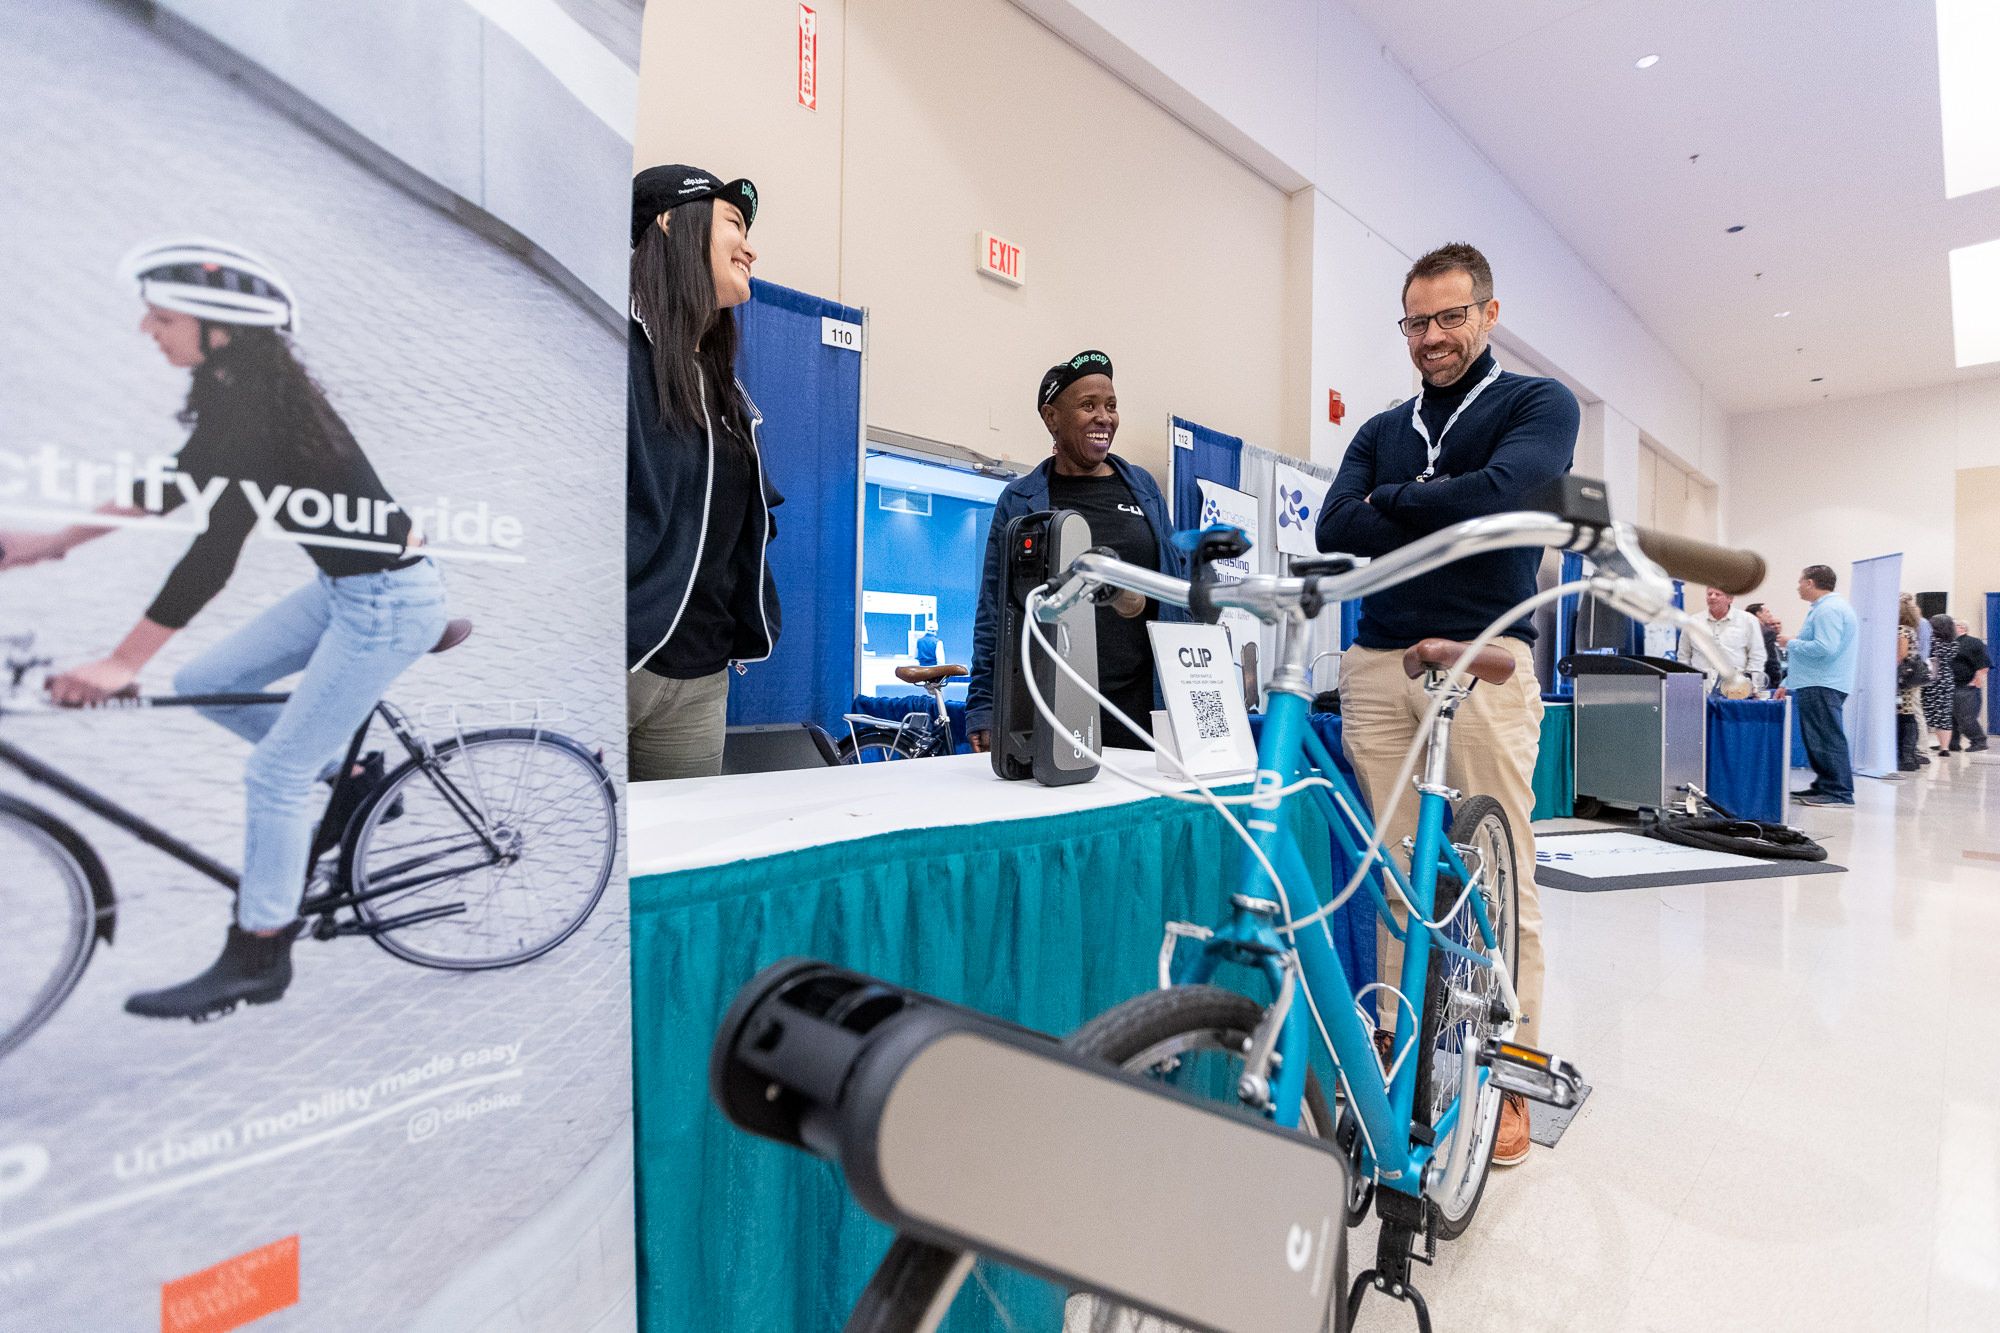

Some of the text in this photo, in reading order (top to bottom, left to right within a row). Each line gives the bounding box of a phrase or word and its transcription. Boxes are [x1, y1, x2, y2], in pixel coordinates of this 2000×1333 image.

[741, 181, 754, 201] bike
[989, 236, 1020, 278] EXIT
[831, 328, 852, 345] 110
[1071, 353, 1109, 370] bike easy
[1178, 433, 1189, 446] 112
[238, 478, 400, 541] your
[408, 496, 525, 549] ride
[1117, 503, 1145, 517] CLI
[1178, 647, 1212, 668] CLIP
[114, 1042, 523, 1180] Urban mobility made easy
[443, 1092, 523, 1123] clipbike
